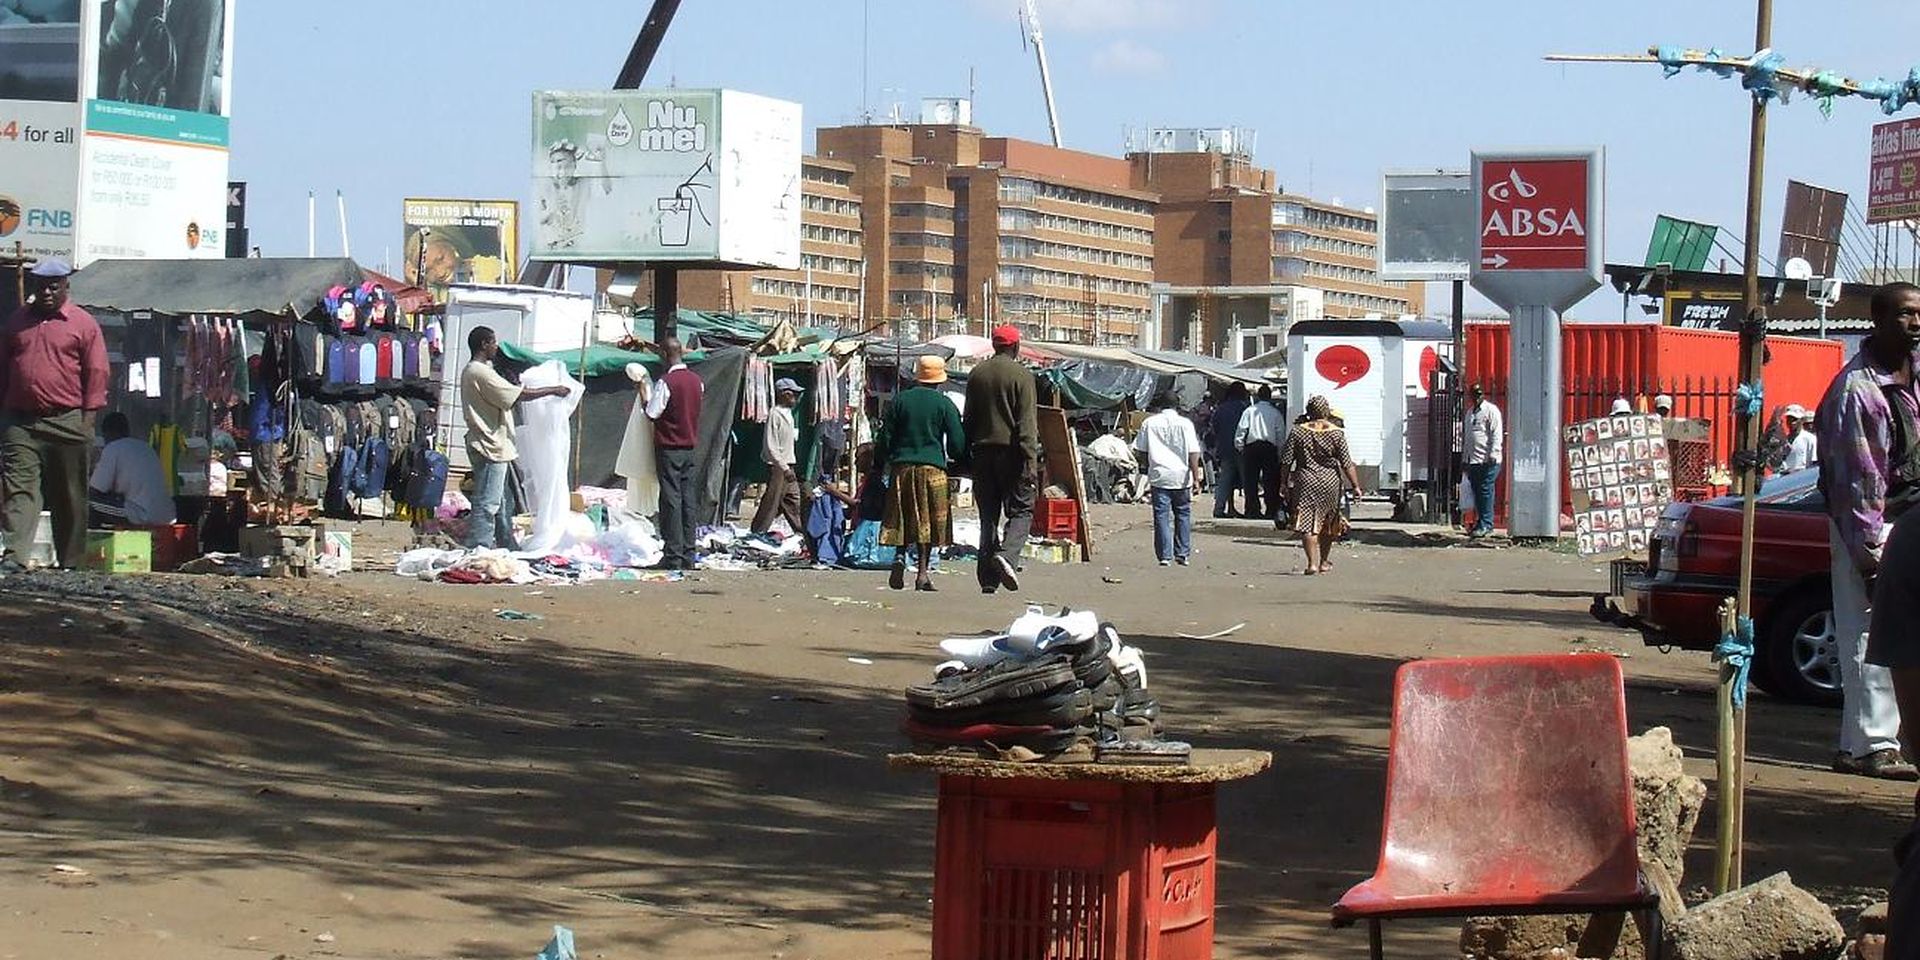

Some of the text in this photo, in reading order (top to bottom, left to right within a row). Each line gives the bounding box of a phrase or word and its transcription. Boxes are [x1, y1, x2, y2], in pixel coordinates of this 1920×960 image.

[647, 100, 697, 130] Nu
[24, 125, 49, 142] for
[54, 127, 73, 144] all
[639, 123, 706, 152] mel
[28, 209, 72, 228] FNB
[408, 206, 429, 217] FOR
[462, 207, 471, 217] A
[473, 206, 512, 218] MONTH
[1482, 208, 1585, 236] ABSA
[1683, 304, 1730, 319] FRESH
